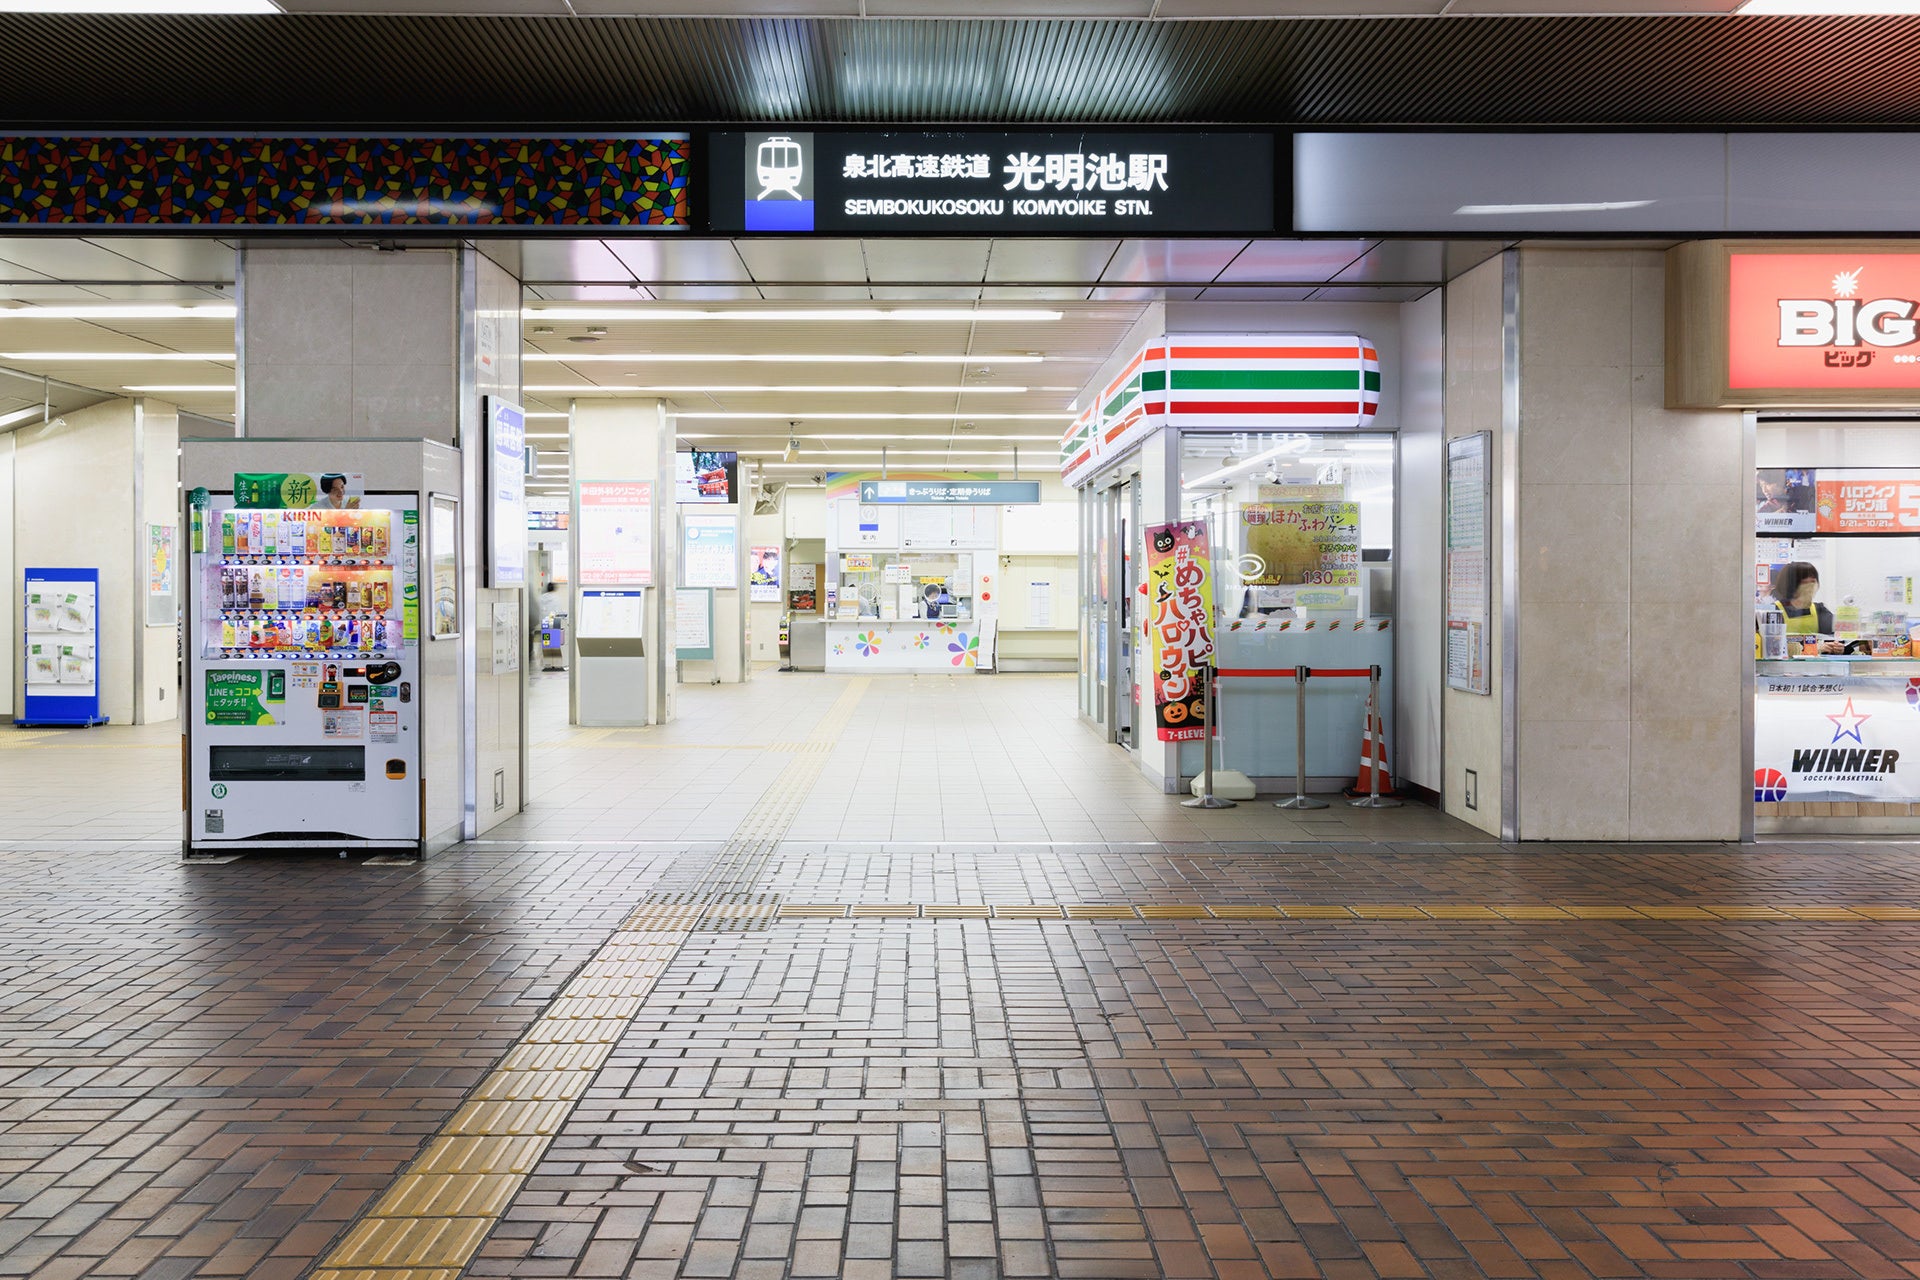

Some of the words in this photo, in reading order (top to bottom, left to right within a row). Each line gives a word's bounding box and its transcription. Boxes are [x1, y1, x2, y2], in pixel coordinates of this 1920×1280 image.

[842, 153, 991, 179] 泉北高速鉄道
[1003, 152, 1169, 193] 光明池駅
[844, 199, 1004, 216] SEMBOKUKOSOKU
[1012, 199, 1107, 216] KOMYOIKE
[1114, 199, 1154, 216] STN.
[1777, 298, 1917, 348] BIG
[1824, 350, 1876, 367] ビッグ
[287, 479, 311, 504] 新
[1845, 498, 1889, 512] ジャンボ
[283, 511, 322, 522] KIRIN
[1764, 518, 1793, 526] WINNER
[1154, 599, 1190, 701] ハロウィン
[210, 671, 258, 684] Tappiness
[1168, 728, 1205, 740] 7-ELEVE
[1791, 748, 1900, 773] WINNER
